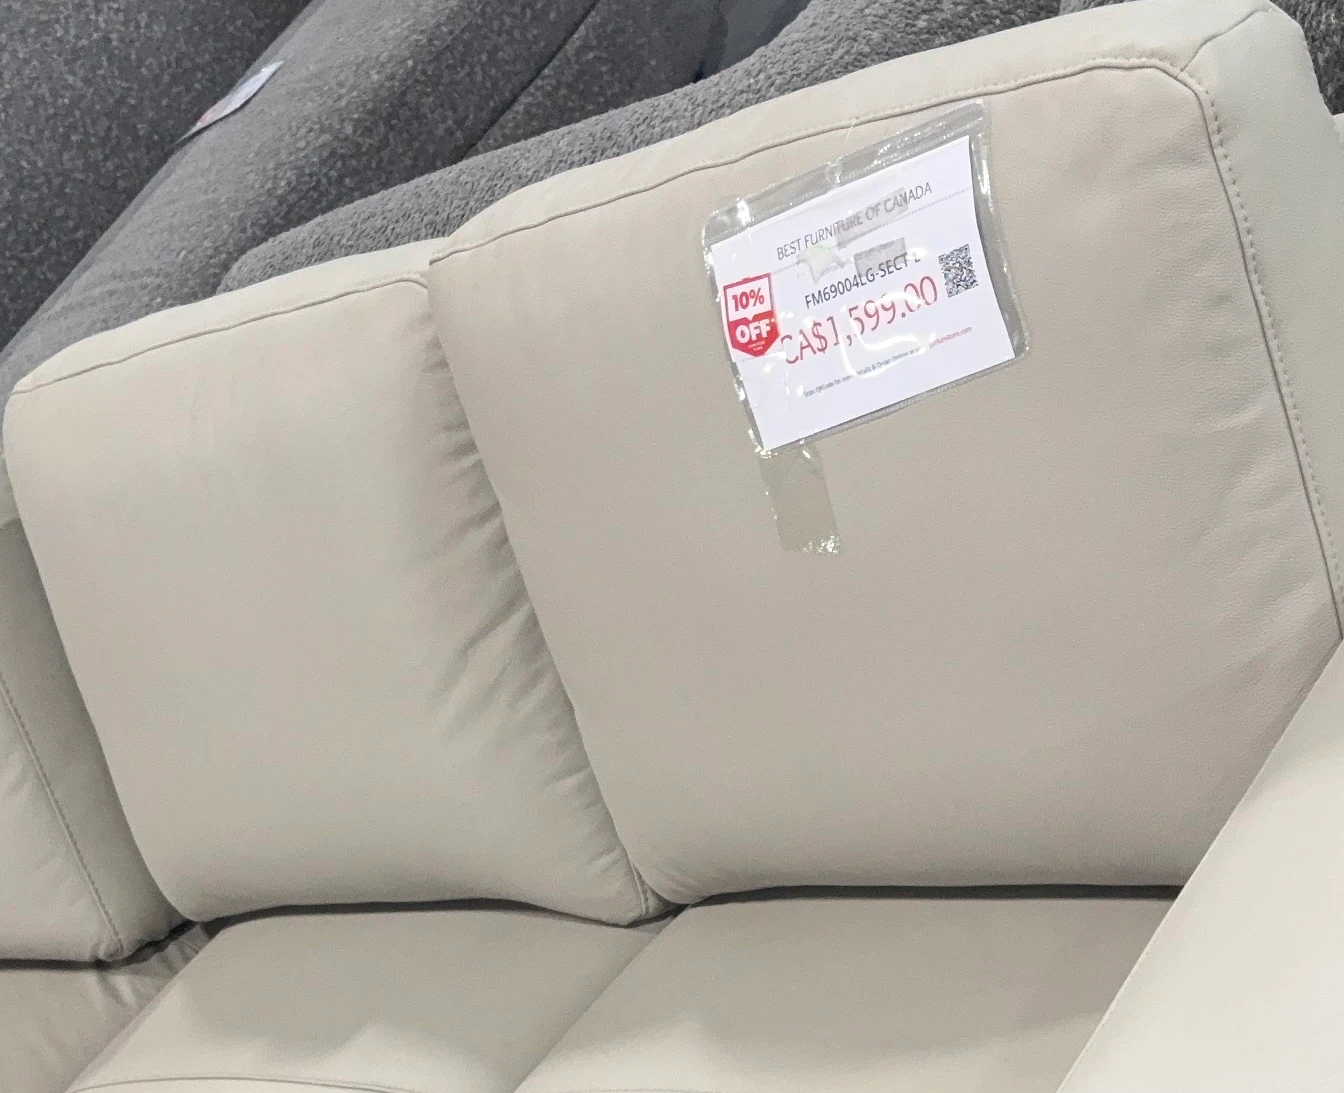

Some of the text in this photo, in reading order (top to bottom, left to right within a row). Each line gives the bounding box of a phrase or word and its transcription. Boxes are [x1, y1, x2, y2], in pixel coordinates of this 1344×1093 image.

[777, 182, 933, 260] BEST FURNITURE OF CANADA
[732, 287, 765, 312] 10%
[804, 252, 921, 309] FM69004LG-SECTL
[735, 318, 771, 344] OFF
[780, 275, 938, 364] CA$1,599.00
